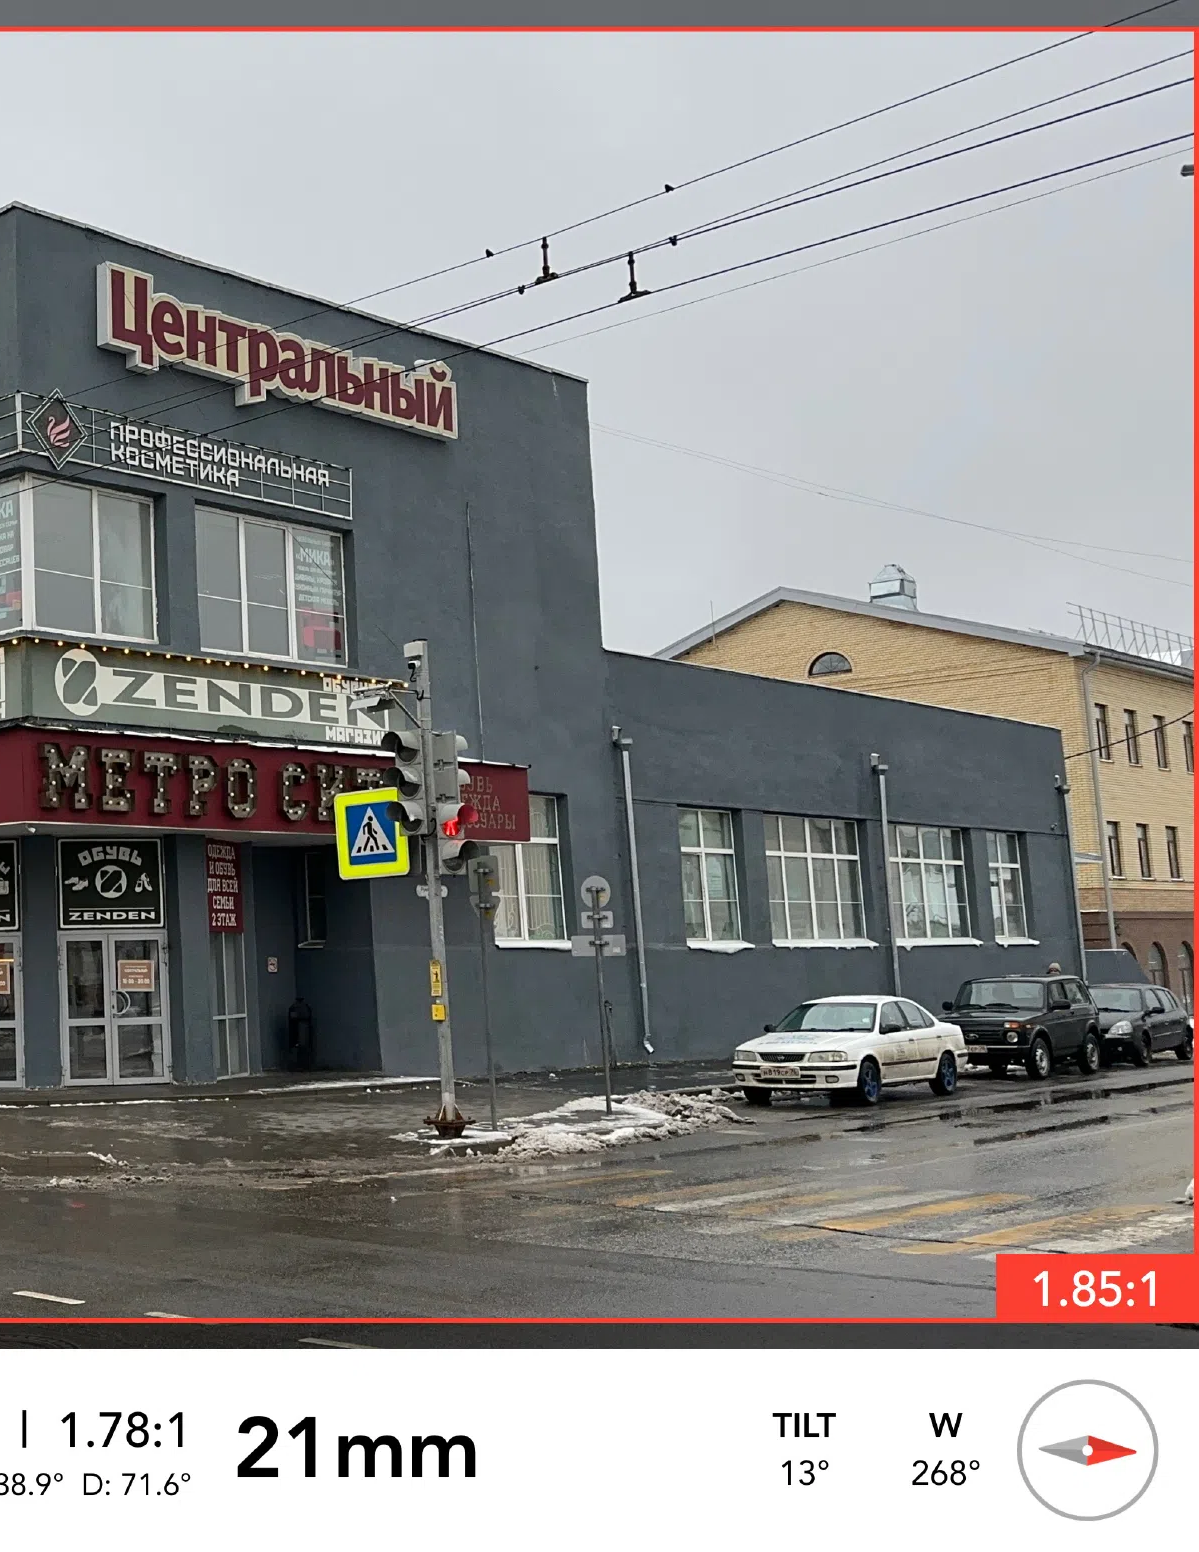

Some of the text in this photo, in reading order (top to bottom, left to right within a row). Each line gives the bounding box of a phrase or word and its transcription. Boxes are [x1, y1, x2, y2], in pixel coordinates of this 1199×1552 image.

[110, 269, 454, 431] Центральный
[110, 421, 329, 488] ПРОФЕССИОНАЛЬНАЯ
[111, 443, 240, 488] КОСМЕТИКА
[111, 668, 386, 730] ZENDEN
[40, 743, 259, 818] МЕТРО
[77, 845, 142, 866] ОБУВЬ
[207, 844, 236, 860] ОДЕЖДА
[209, 861, 236, 876] И ОБУВЬ
[207, 877, 239, 893] ДЛЯ ВСЕЙ
[212, 895, 235, 910] СЕМЬИ
[68, 911, 156, 921] ZENDEN
[211, 912, 237, 926] 2 ЭТАЖ
